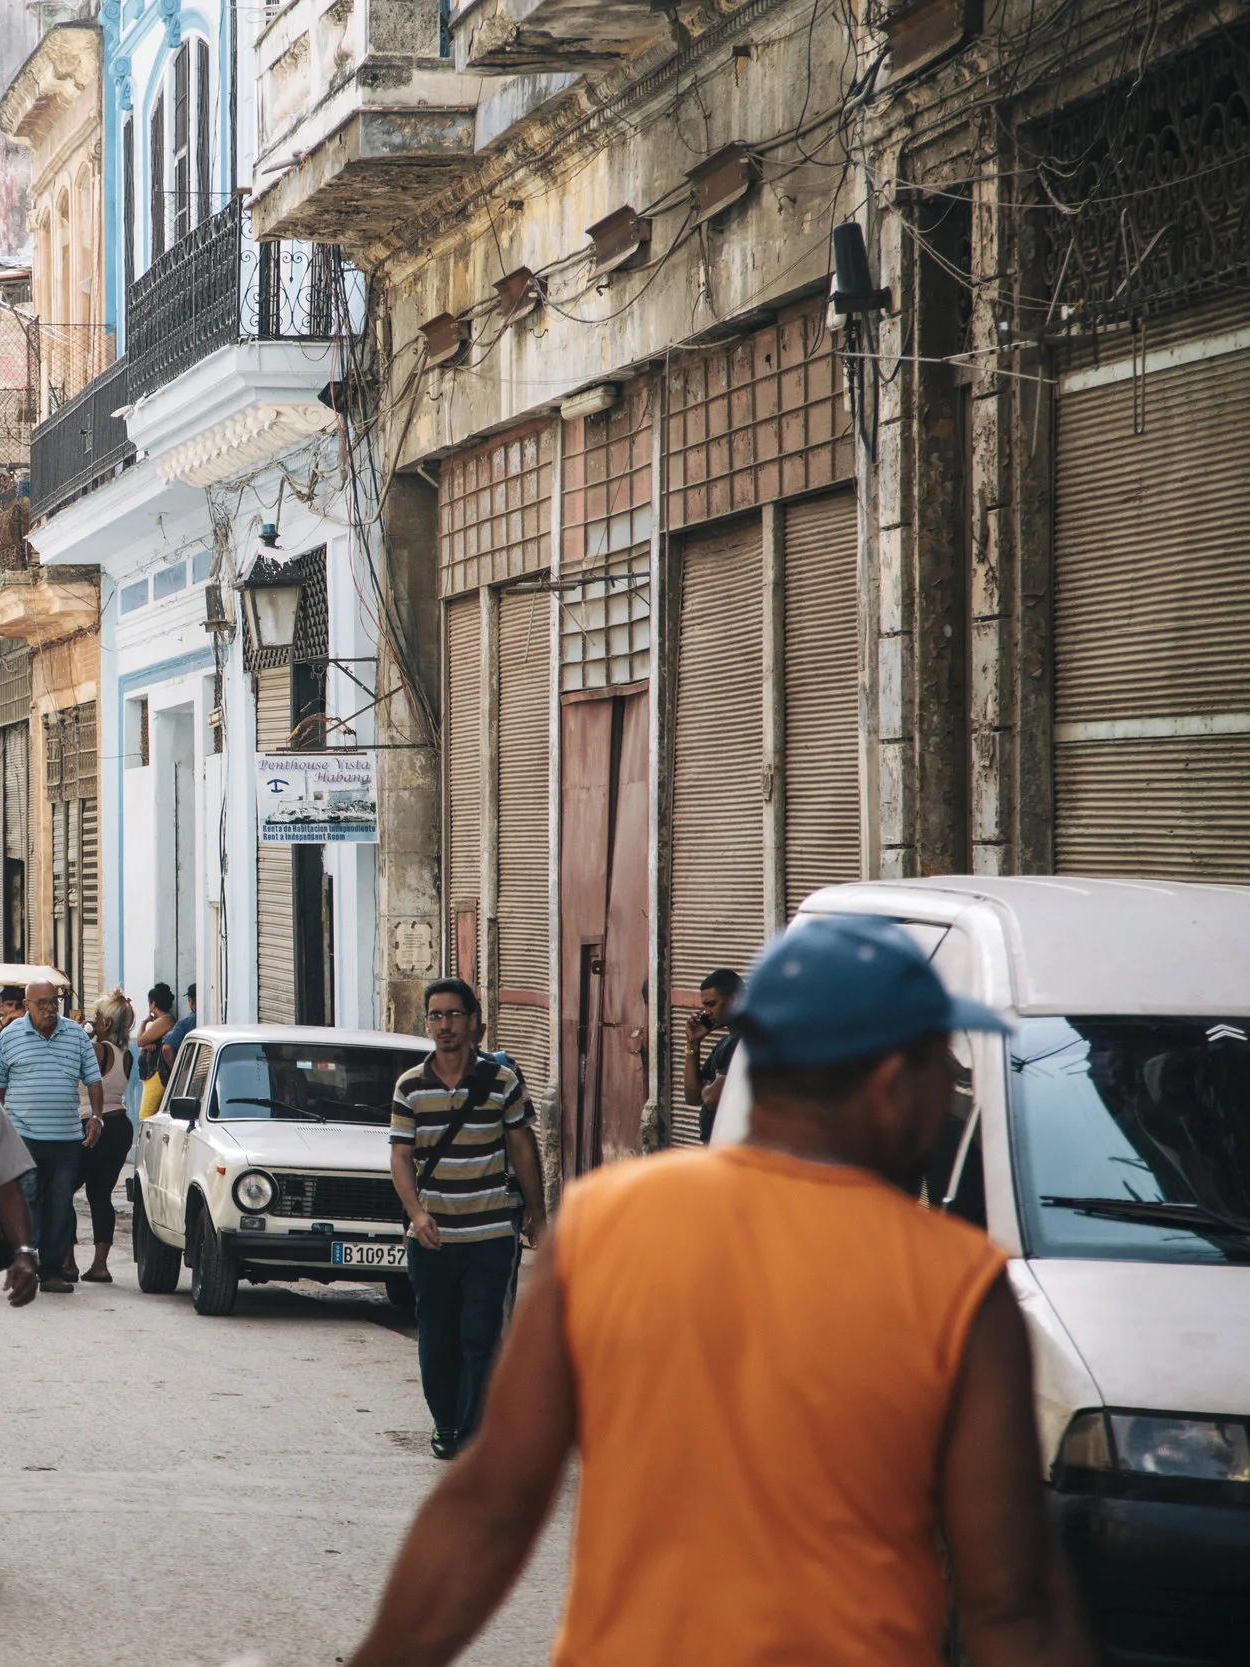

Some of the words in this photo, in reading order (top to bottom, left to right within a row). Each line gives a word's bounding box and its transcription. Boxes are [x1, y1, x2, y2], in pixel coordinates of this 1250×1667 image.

[258, 758, 328, 770] Penthouse
[334, 758, 371, 770] Vista
[314, 770, 371, 783] Habana
[263, 825, 282, 833] Renta
[283, 825, 291, 833] de
[293, 825, 328, 833] Habitacion
[329, 825, 375, 833] Independiente
[285, 833, 325, 841] Independent
